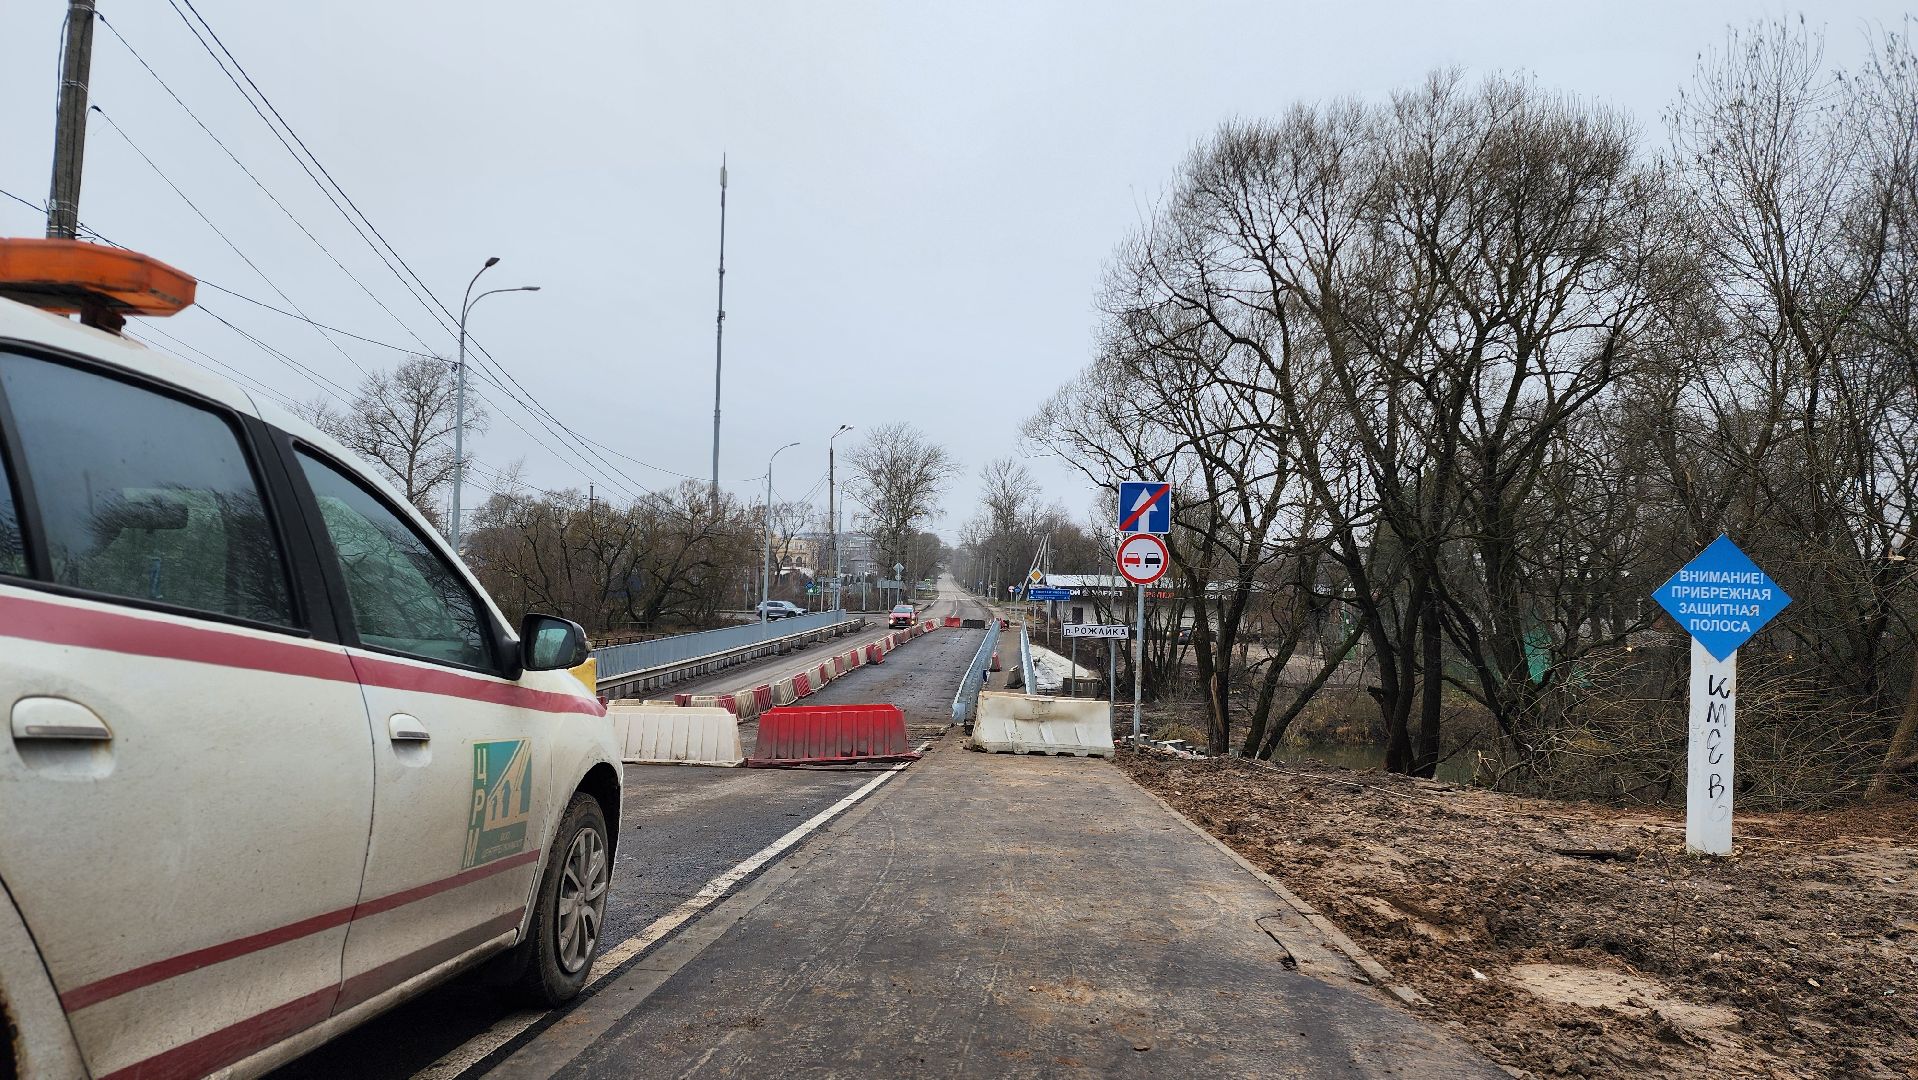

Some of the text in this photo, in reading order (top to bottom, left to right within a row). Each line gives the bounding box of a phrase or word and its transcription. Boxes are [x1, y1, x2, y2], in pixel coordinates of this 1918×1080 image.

[1680, 570, 1764, 584] ВНИМАНИЕ!
[1671, 586, 1771, 600] ПРИБРЕЖНАЯ
[1679, 602, 1760, 617] ЗАЩИТНАЯ
[1690, 619, 1751, 632] ПОЛОСА
